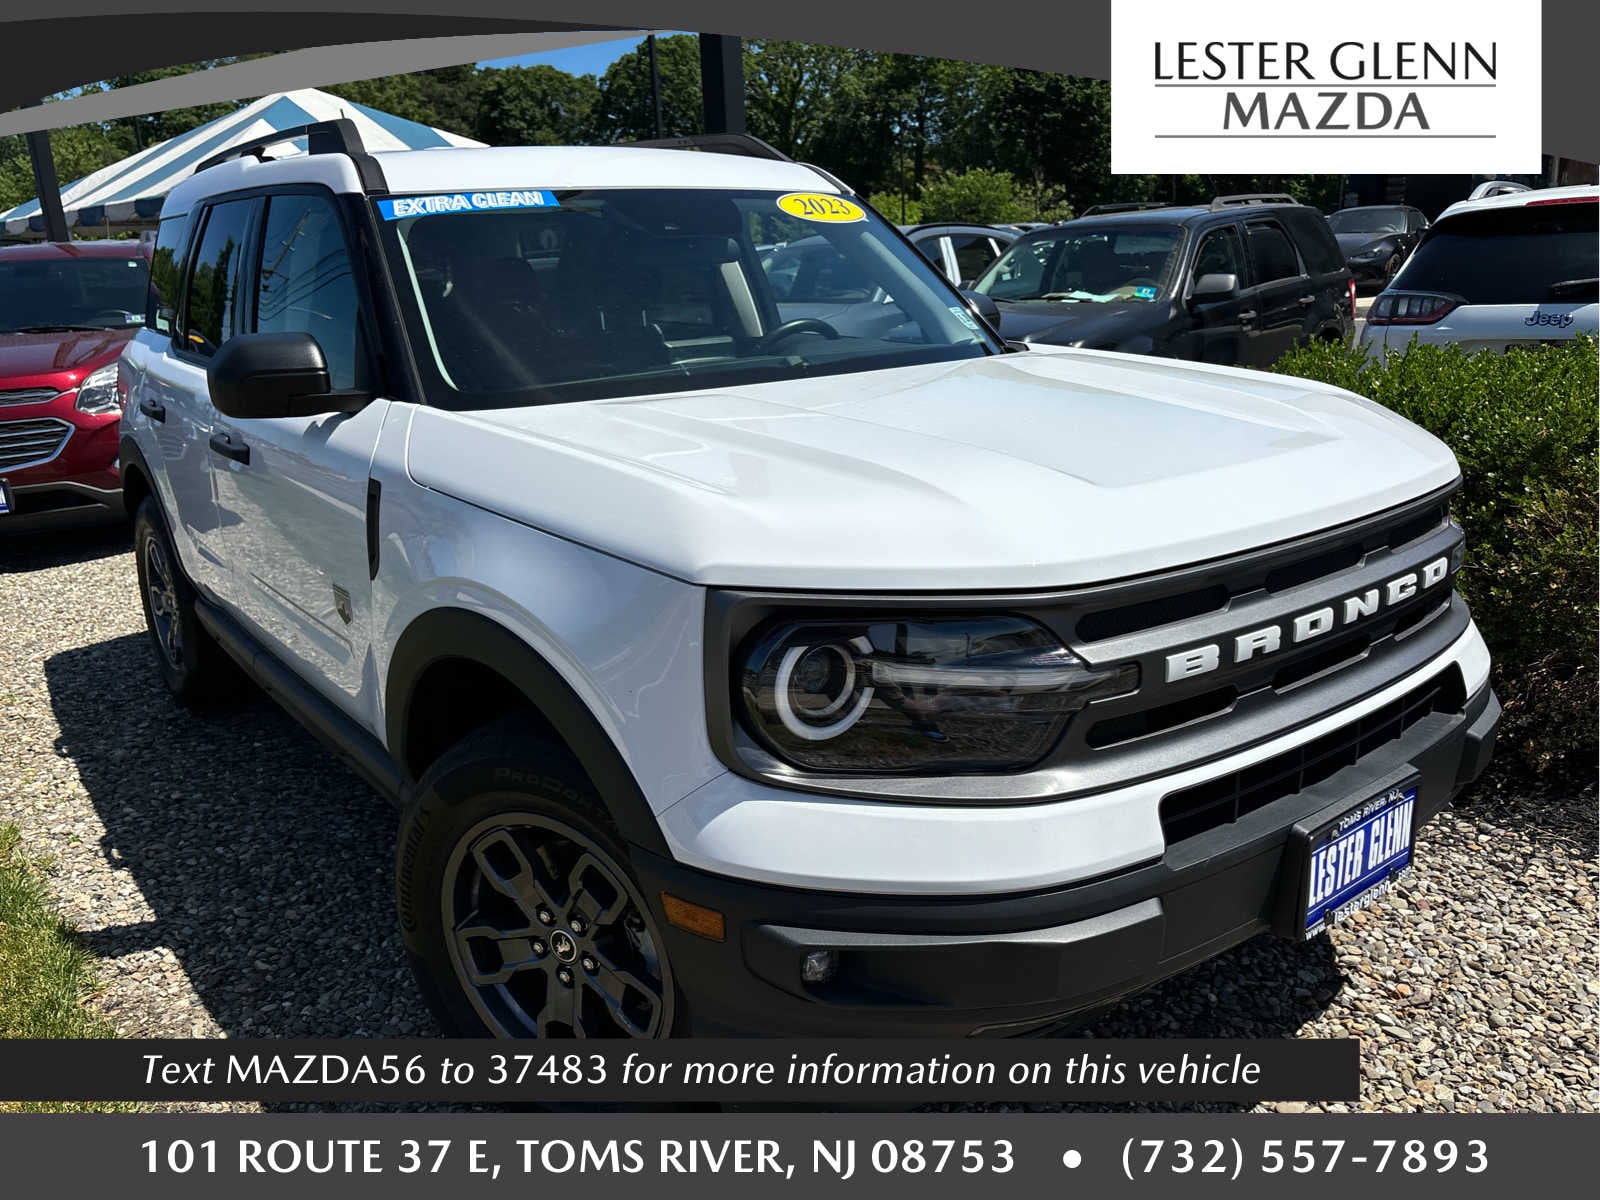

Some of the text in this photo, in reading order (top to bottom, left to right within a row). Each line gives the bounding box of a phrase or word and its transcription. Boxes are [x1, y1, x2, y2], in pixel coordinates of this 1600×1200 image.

[392, 190, 544, 217] EXTRA CLEAN
[793, 198, 850, 215] 2023
[1525, 311, 1574, 328] Jeep
[1165, 557, 1448, 683] BRONCO
[1308, 800, 1414, 908] LESTER GLENN
